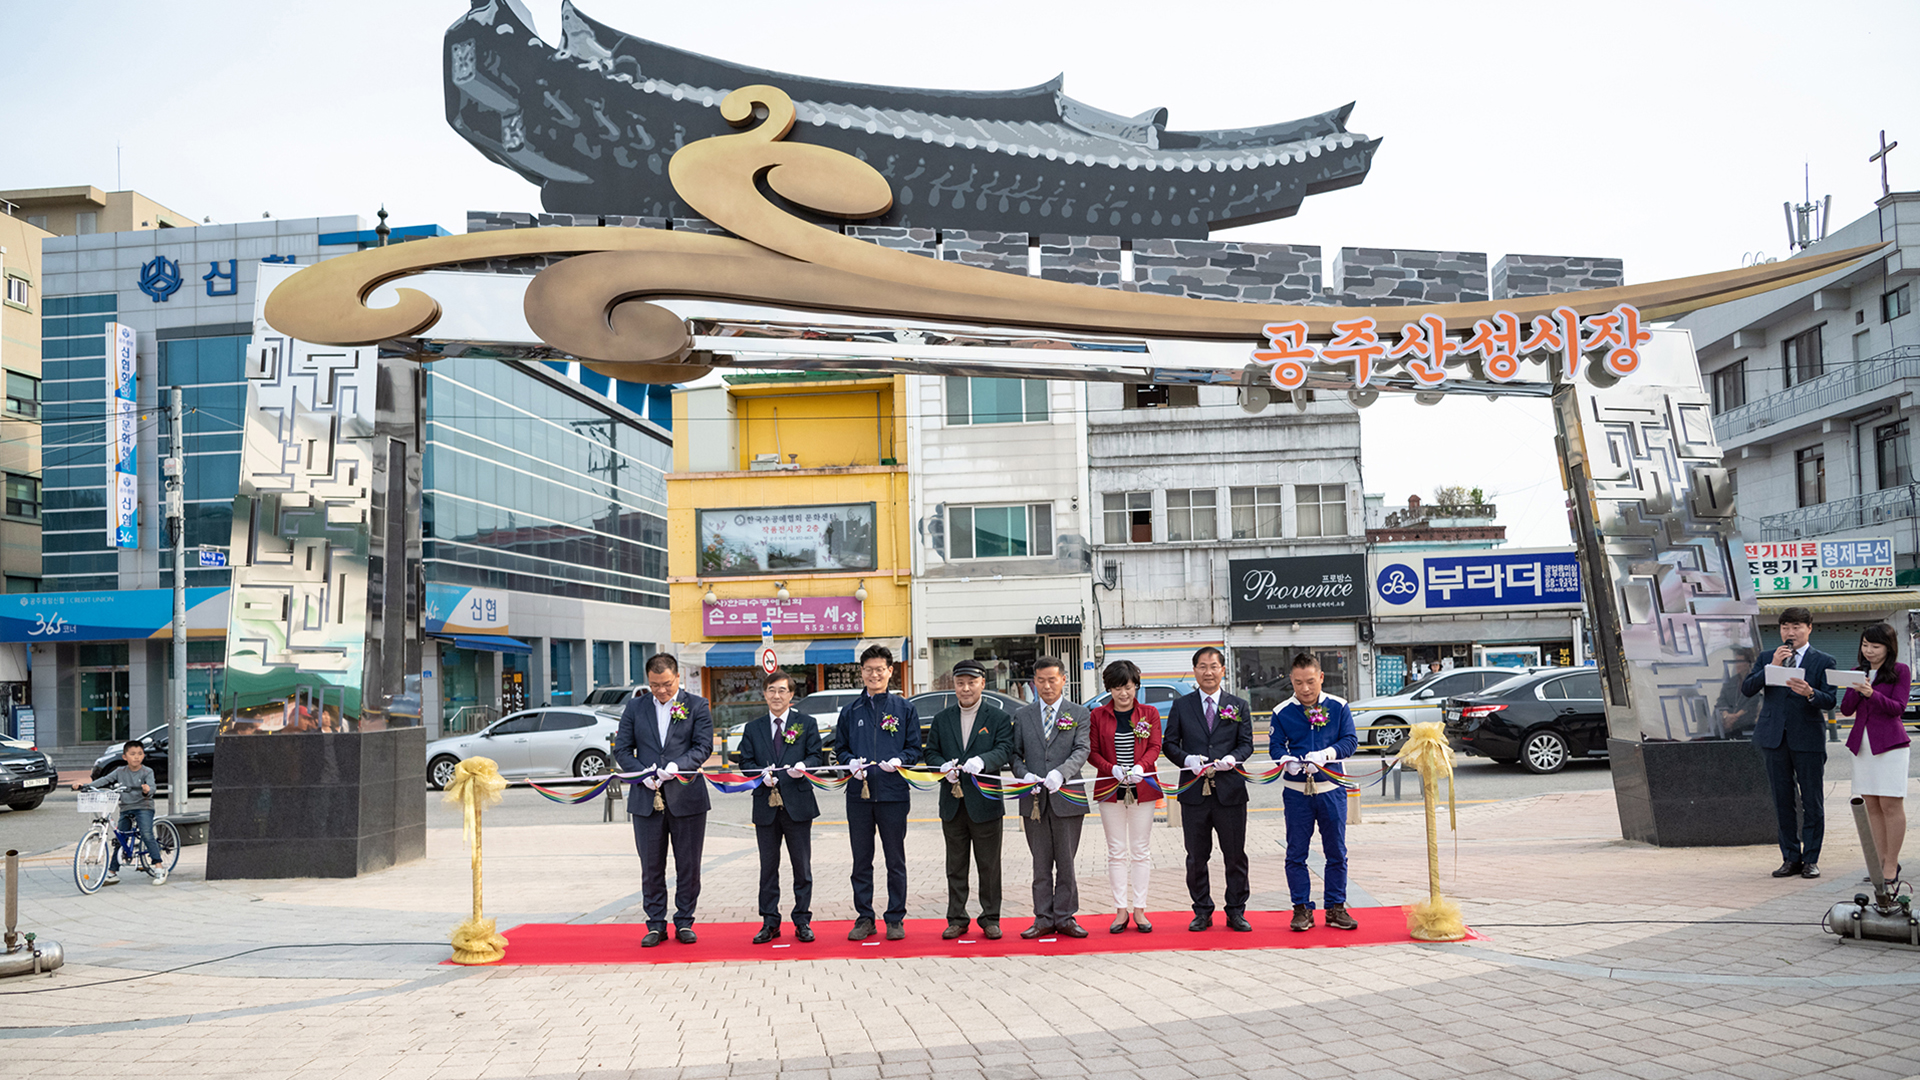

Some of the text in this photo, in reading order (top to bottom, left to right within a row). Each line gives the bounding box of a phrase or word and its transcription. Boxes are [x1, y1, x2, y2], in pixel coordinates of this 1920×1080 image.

[1251, 304, 1653, 389] 공주산성시장
[122, 497, 132, 527] 신협
[747, 512, 838, 524] 한국수공예협회 문화센터
[762, 524, 819, 534] 작품전시장 2층
[1744, 542, 1817, 559] 전기재료
[1823, 541, 1889, 565] 형제무선
[1748, 559, 1818, 575] 조명기구
[1829, 567, 1893, 578] 852-4775
[1243, 569, 1353, 601] Provence
[1322, 574, 1352, 583] 프로방스
[1428, 562, 1542, 600] 부라더
[1830, 578, 1893, 589] 010-7720-4775
[470, 598, 497, 621] 신협
[709, 605, 858, 625] 손으로 만드는 세상
[27, 612, 77, 635] 365 코너
[1036, 615, 1081, 624] AGATHA
